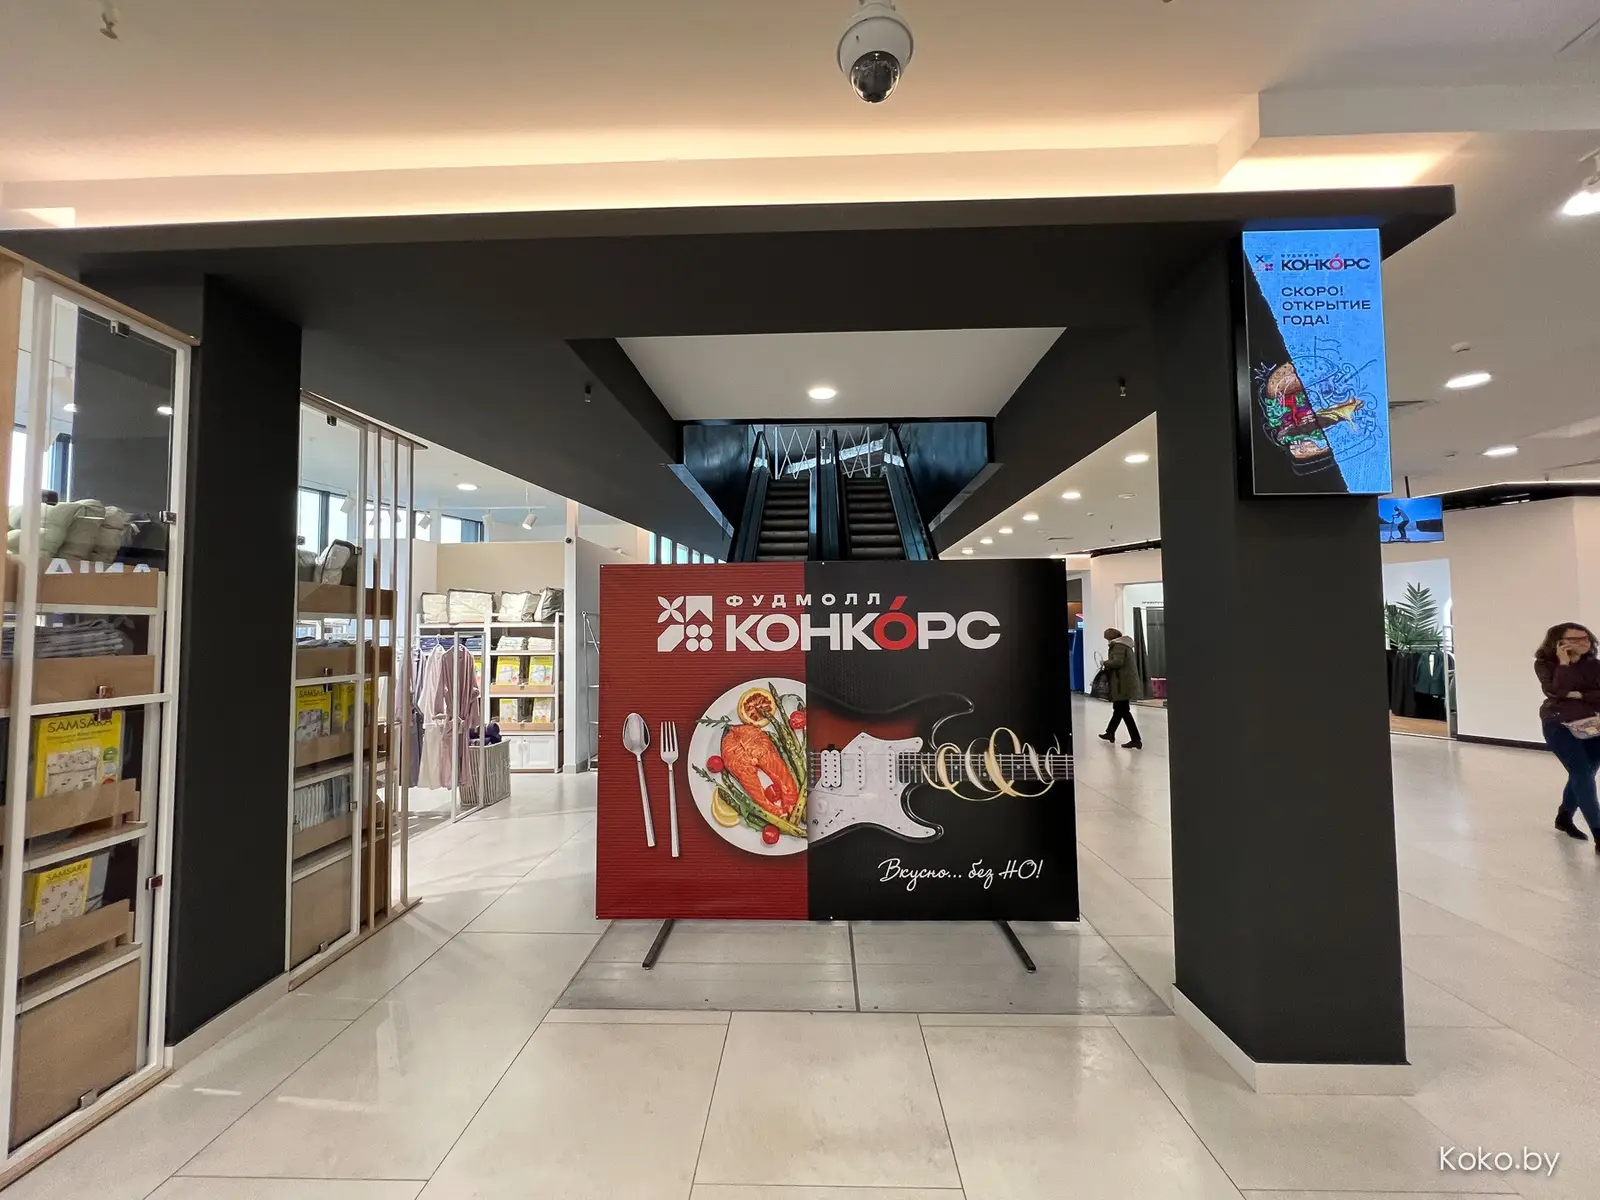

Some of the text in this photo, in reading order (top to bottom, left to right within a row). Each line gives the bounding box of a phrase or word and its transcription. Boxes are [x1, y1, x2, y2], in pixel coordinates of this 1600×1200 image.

[1281, 286, 1344, 297] СКОРО!
[1282, 300, 1371, 311] ОТКРЫТИЕ
[1283, 315, 1330, 327] ГОДА!
[725, 592, 881, 609] ФУДМОЛЛ
[877, 857, 1044, 892] Вкусно... без НО!
